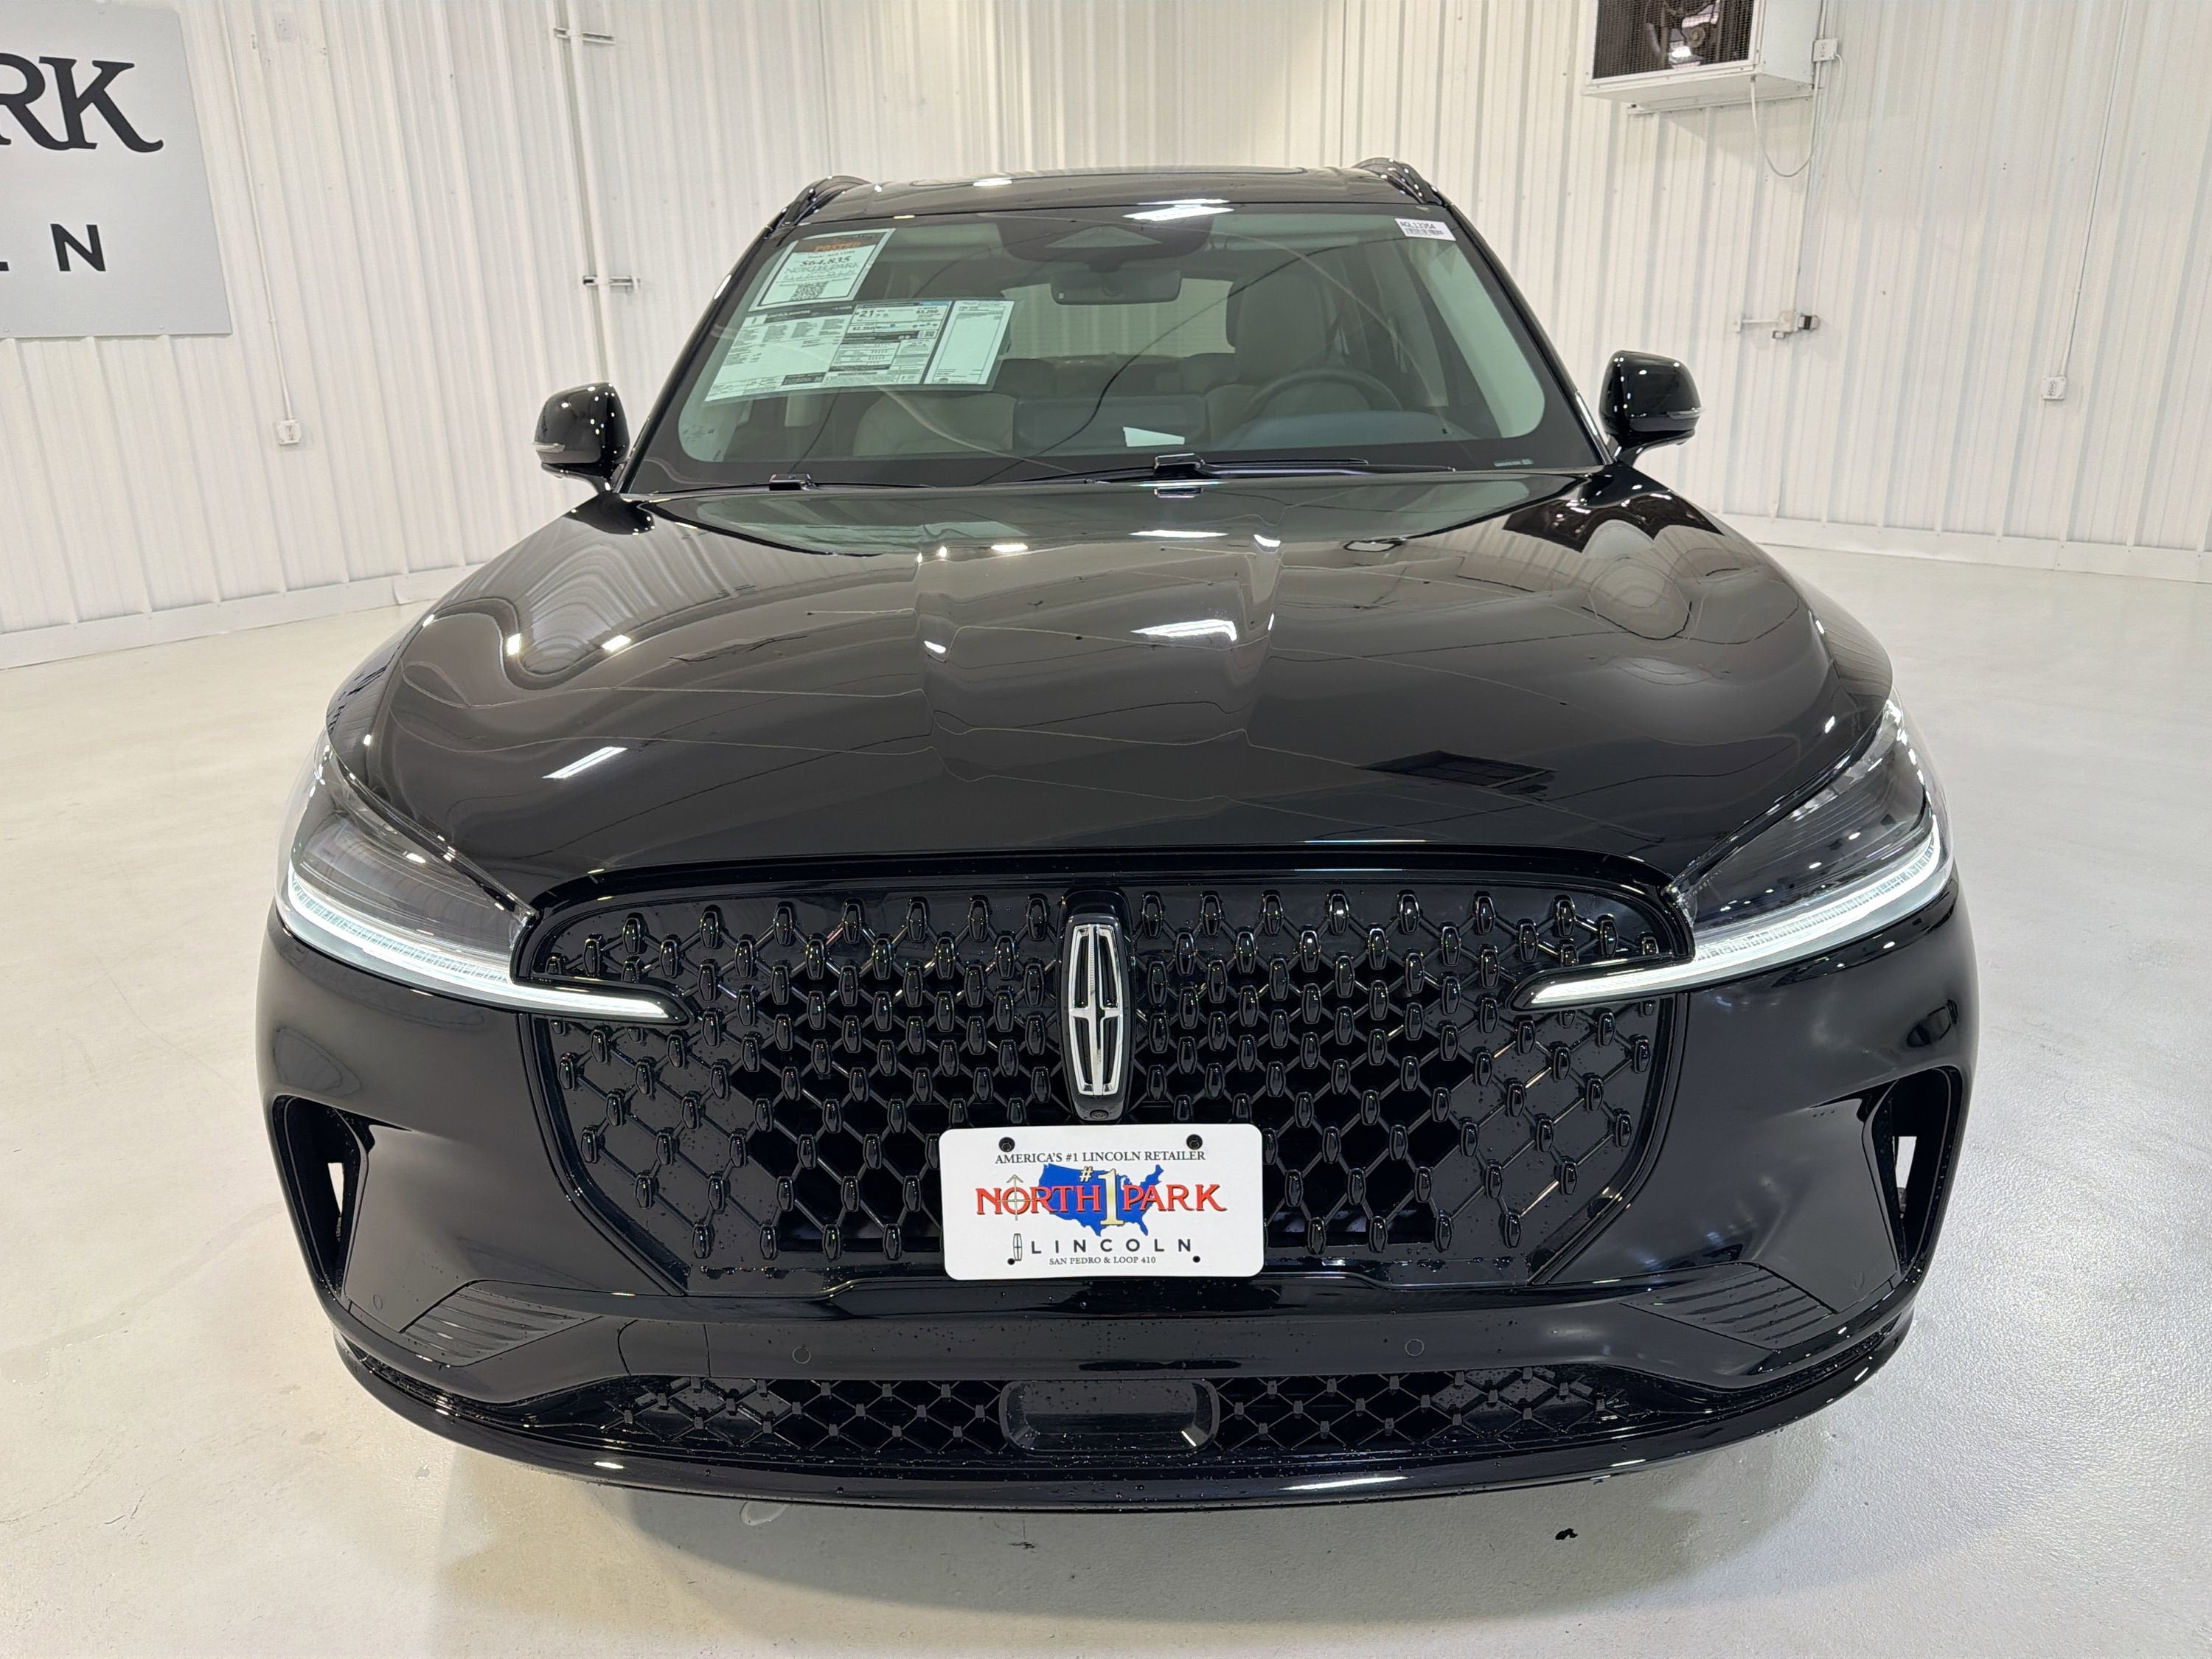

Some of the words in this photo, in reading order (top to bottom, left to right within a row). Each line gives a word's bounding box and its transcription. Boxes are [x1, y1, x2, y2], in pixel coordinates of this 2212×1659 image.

[0, 52, 164, 153] RK
[0, 223, 106, 271] N
[995, 1152, 1063, 1164] AMERICA'S
[1065, 1152, 1079, 1162] #1
[1082, 1151, 1141, 1162] LINCOLN
[1144, 1150, 1206, 1161] RETAILER
[975, 1183, 1101, 1215] NORTH
[1123, 1183, 1228, 1212] PARK
[1031, 1238, 1192, 1254] LINCOLN
[1048, 1257, 1068, 1265] SAN
[1069, 1256, 1102, 1265] PEDRO
[1113, 1256, 1139, 1264] LOOP
[1141, 1256, 1156, 1264] 410
